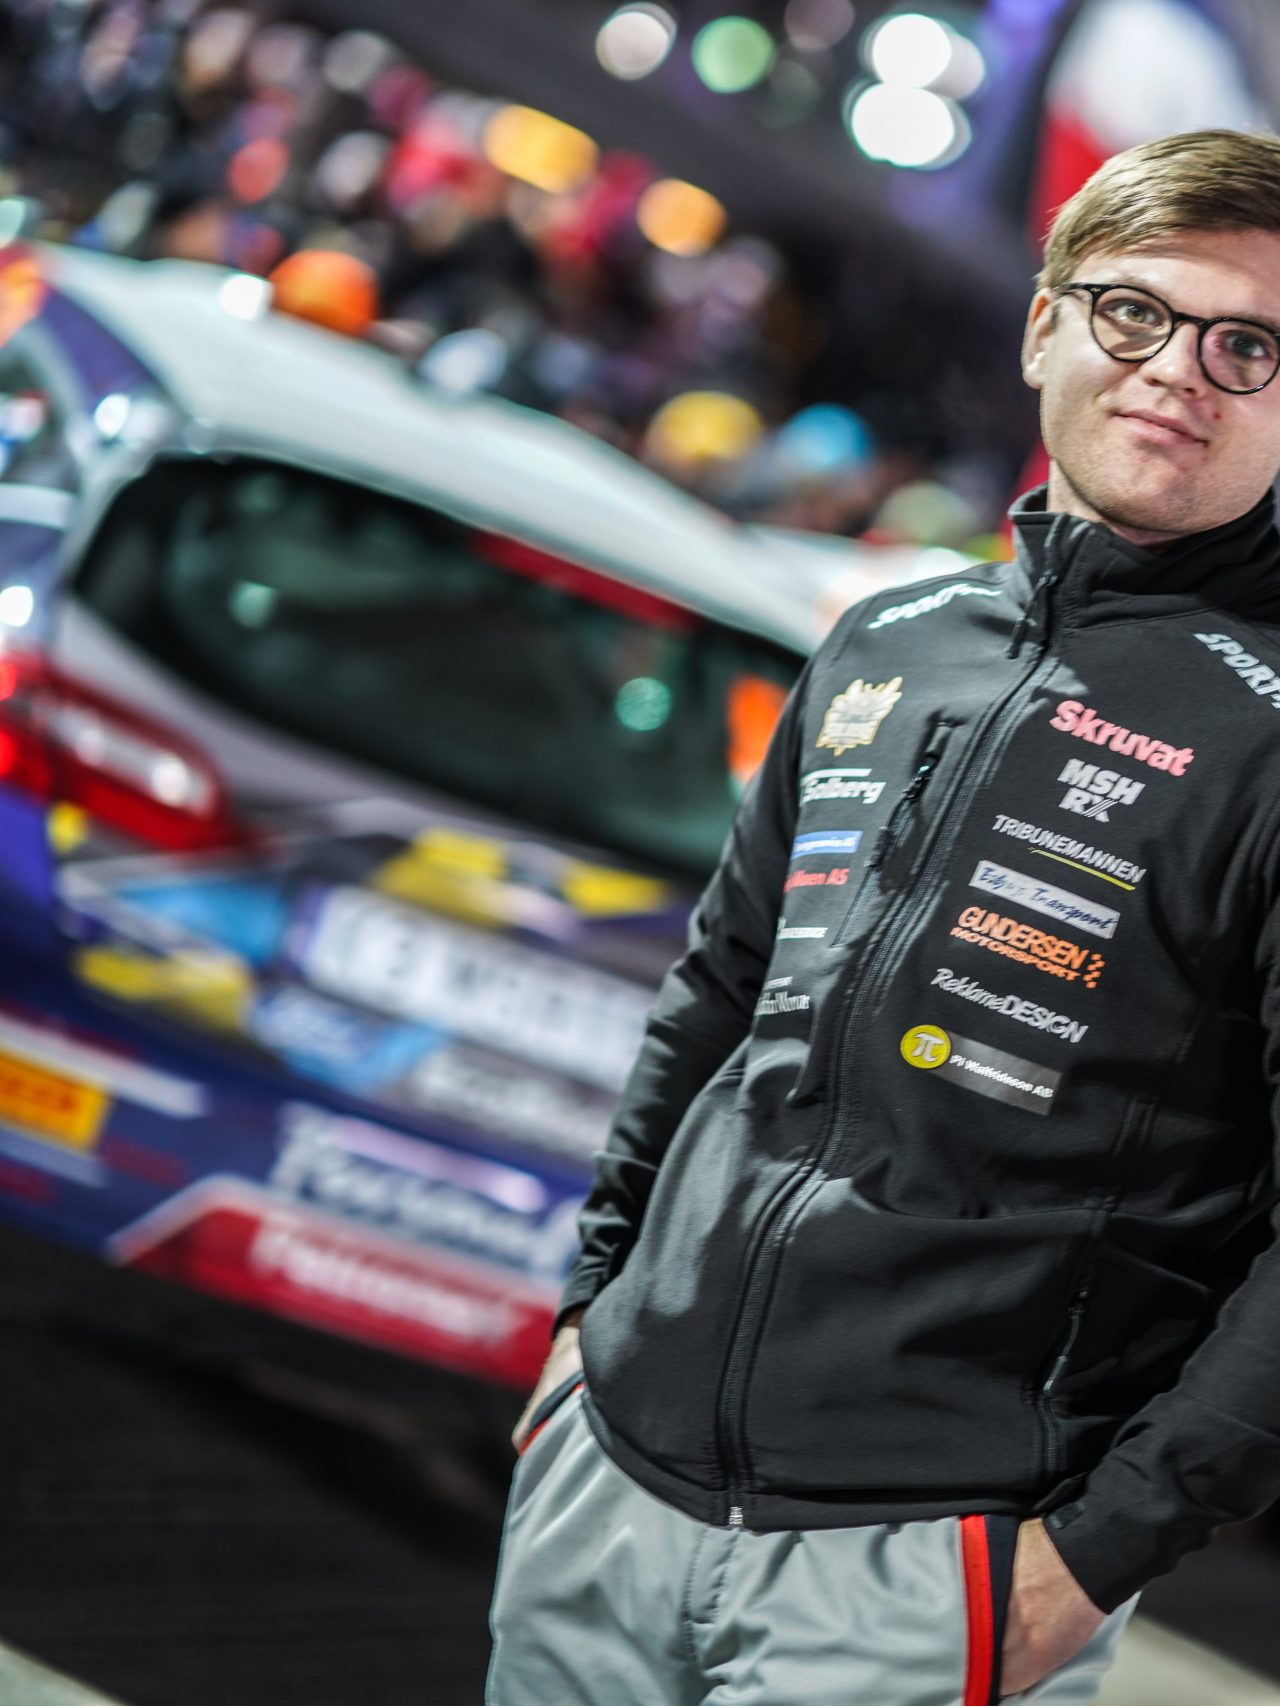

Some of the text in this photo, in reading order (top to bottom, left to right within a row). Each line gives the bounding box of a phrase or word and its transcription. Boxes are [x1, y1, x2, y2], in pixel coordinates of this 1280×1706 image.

[1049, 699, 1195, 777] Skruvat
[1057, 758, 1146, 805] MSH
[992, 814, 1148, 884] TRIBUNEMANNEN
[958, 905, 1090, 970] GUNDERSEN
[1030, 888, 1118, 930] Transport
[950, 926, 1081, 981] MOTORSPORT
